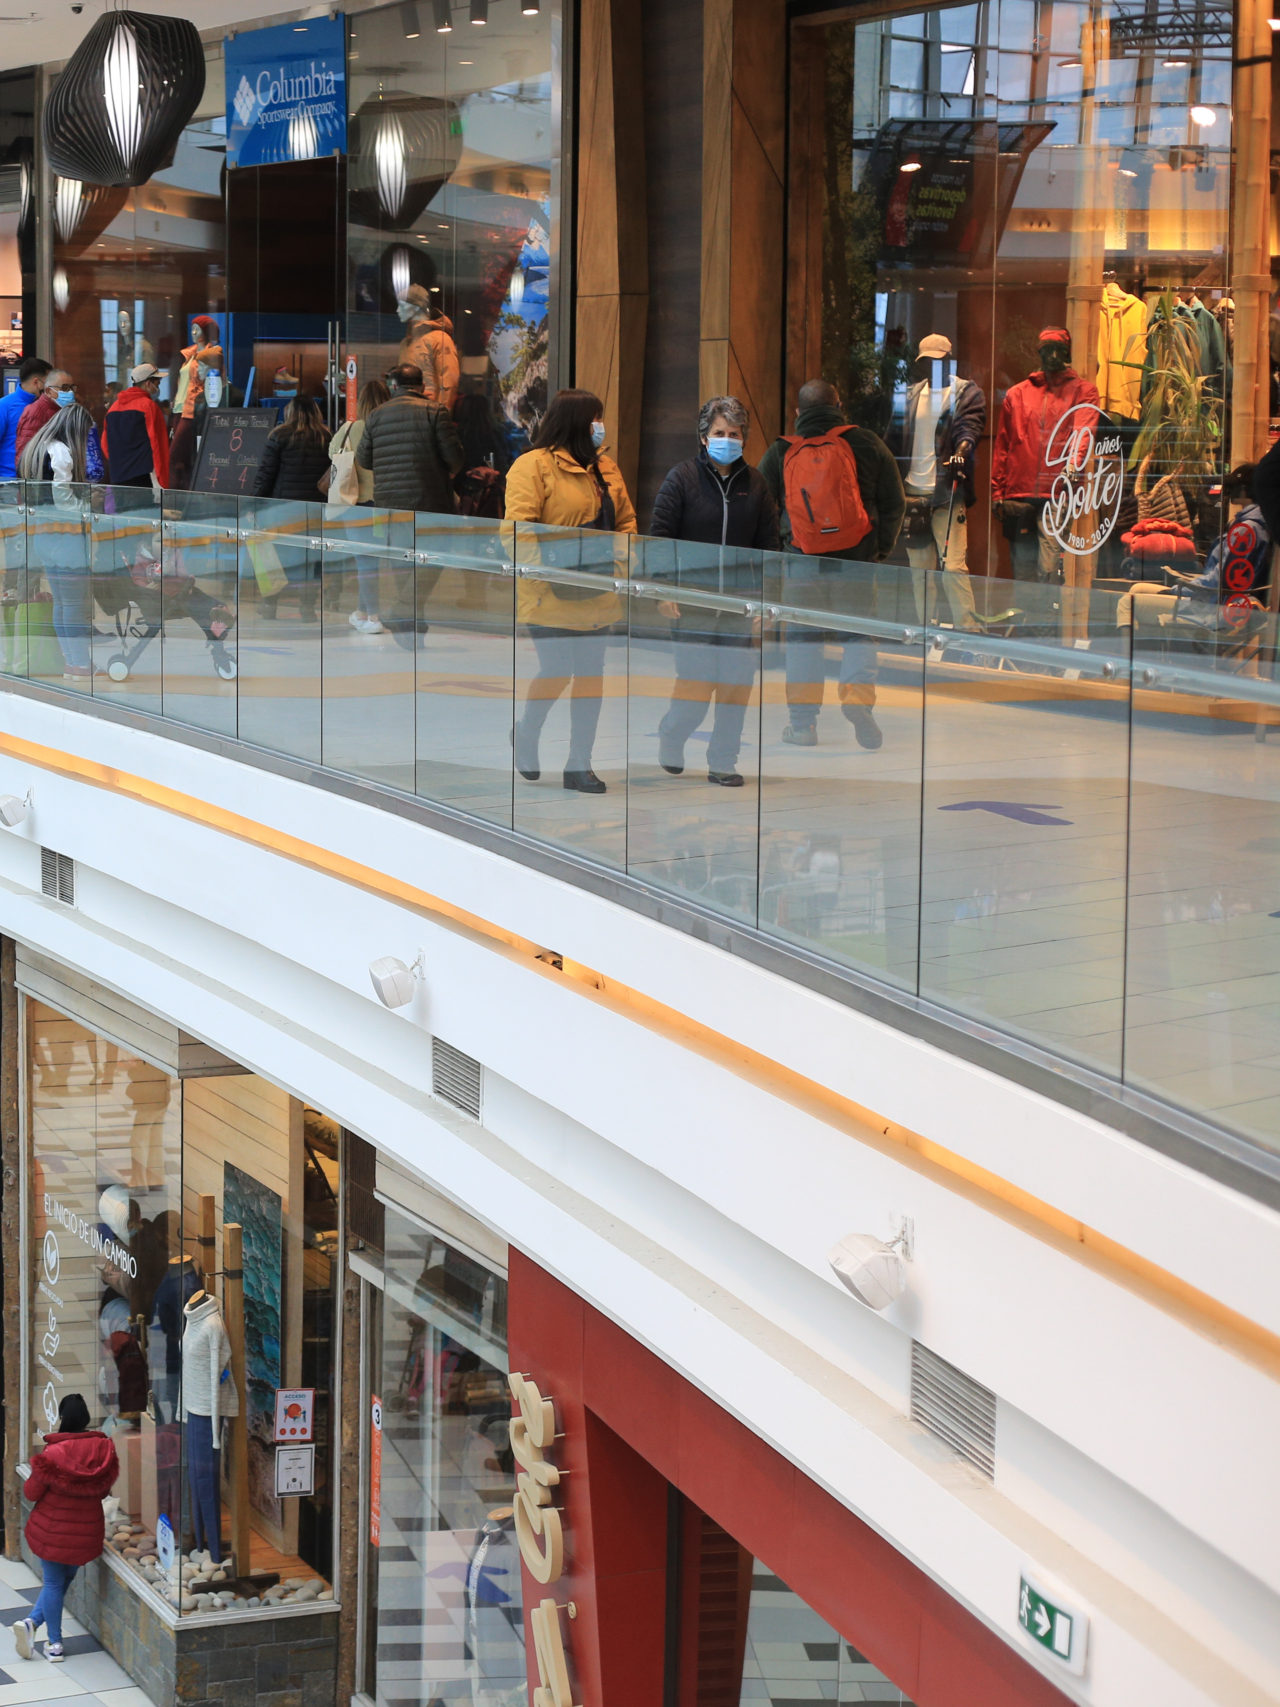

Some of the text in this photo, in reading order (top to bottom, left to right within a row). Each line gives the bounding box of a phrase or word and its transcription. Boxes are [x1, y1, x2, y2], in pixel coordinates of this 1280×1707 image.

[256, 61, 336, 106] Columbia
[257, 101, 336, 129] Sportswear Company
[230, 428, 243, 452] 8
[1046, 426, 1122, 475] 40 años
[238, 466, 248, 489] 4
[1042, 457, 1121, 536] Doite
[44, 1192, 137, 1279] EL INICIO DE UN CAMBIO
